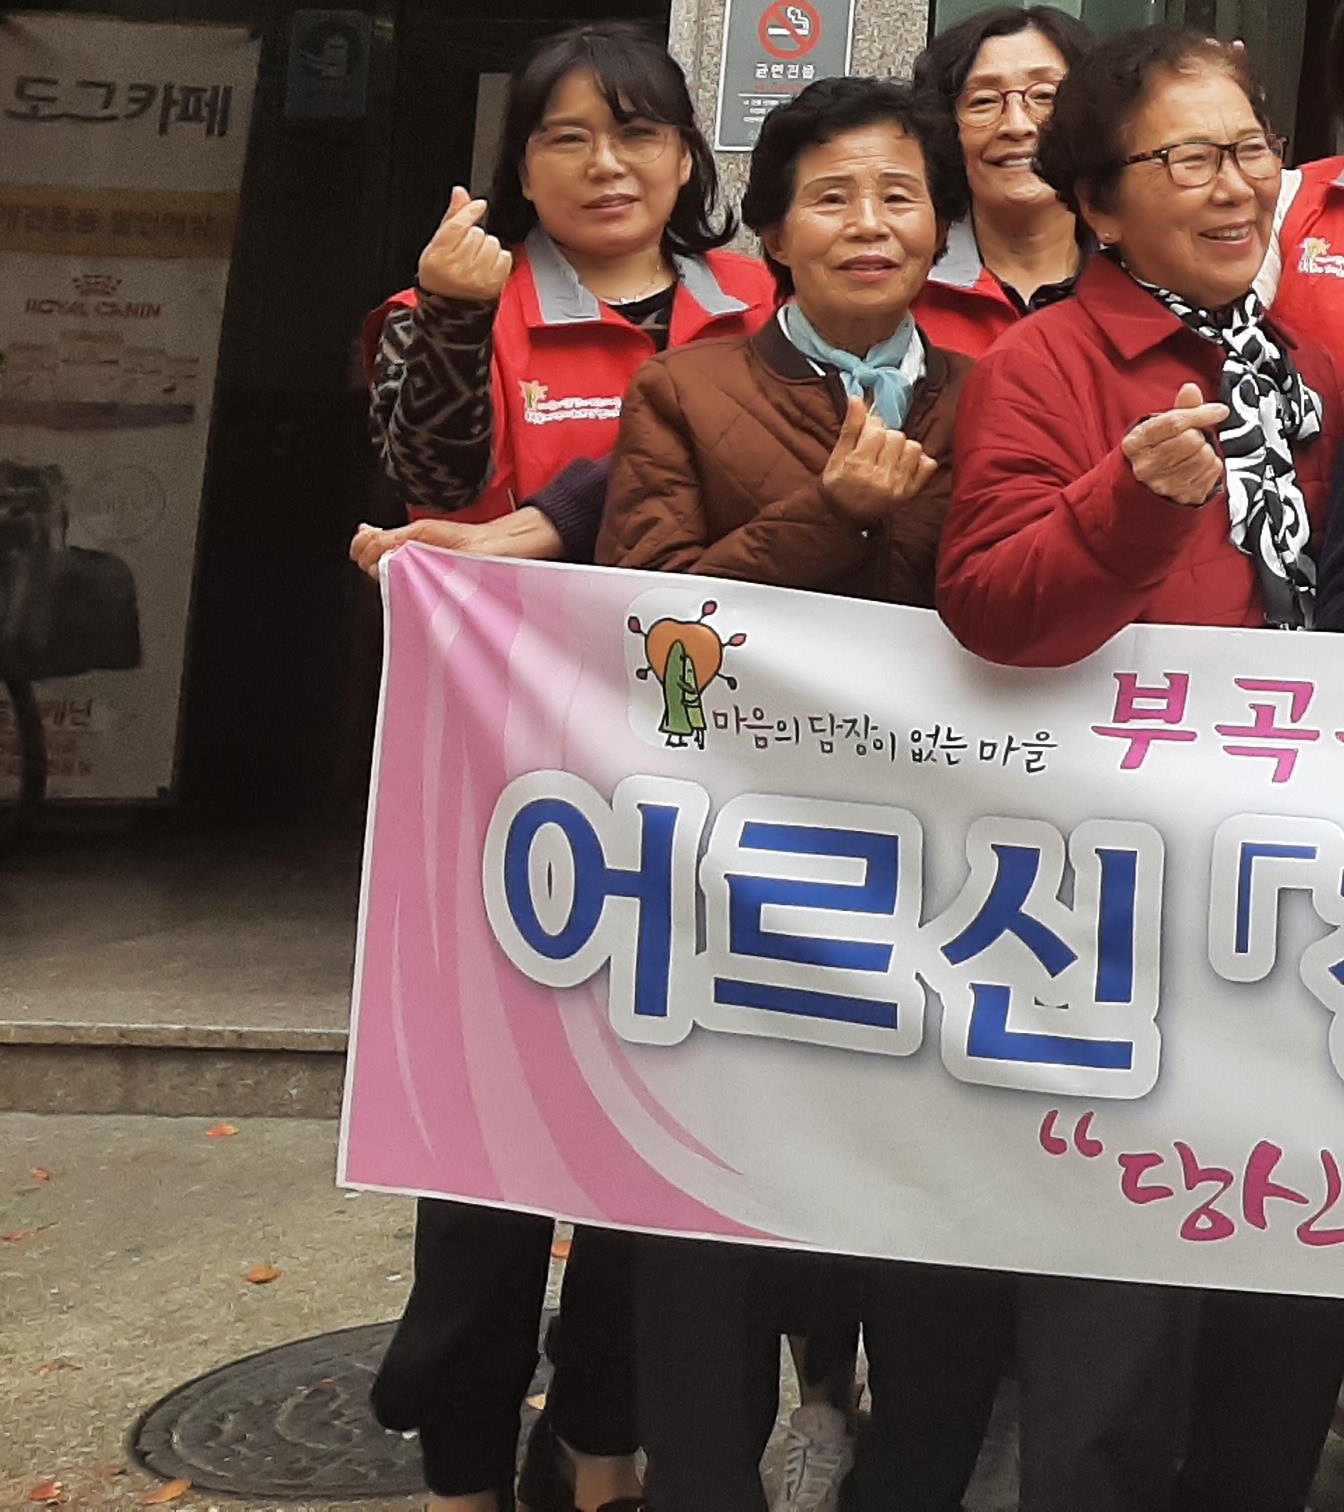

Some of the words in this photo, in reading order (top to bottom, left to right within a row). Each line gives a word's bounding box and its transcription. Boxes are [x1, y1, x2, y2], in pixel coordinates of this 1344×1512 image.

[95, 300, 163, 319] CANIN
[711, 704, 801, 750] 마음의
[808, 712, 897, 763] 담장이
[909, 723, 969, 766] 없는
[979, 728, 1059, 774] 마을
[502, 797, 1140, 1072] 어르신
